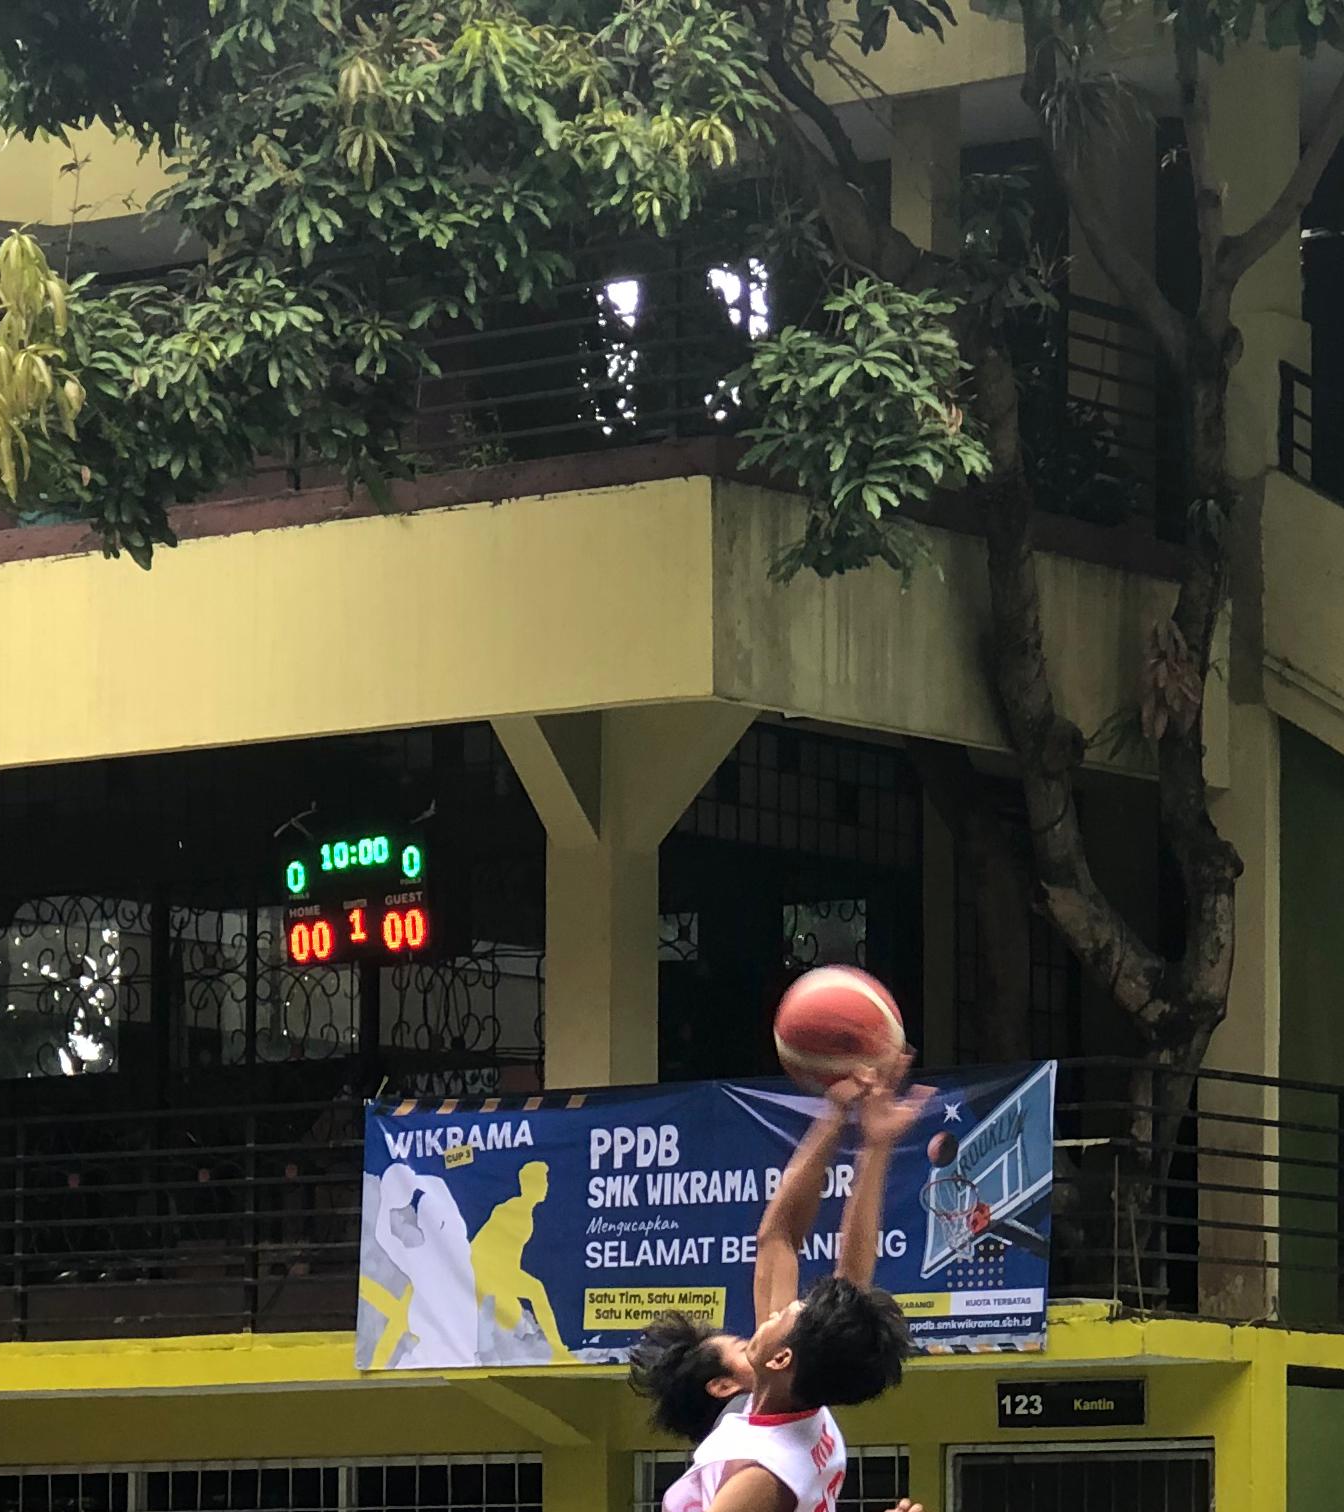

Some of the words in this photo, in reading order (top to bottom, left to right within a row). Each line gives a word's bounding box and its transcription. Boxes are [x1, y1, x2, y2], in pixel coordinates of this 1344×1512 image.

[320, 836, 389, 871] 10:00
[402, 845, 421, 878] 0
[286, 861, 305, 893] 0
[289, 905, 321, 918] HOME
[385, 891, 423, 905] GUEST
[290, 920, 332, 962] 00
[349, 908, 368, 942] 1
[382, 908, 427, 950] 00
[384, 1119, 534, 1160] WIKRAMA
[589, 1124, 680, 1170] PPDB
[446, 1152, 464, 1163] CUP
[587, 1174, 638, 1208] SMK
[646, 1168, 759, 1206] WIKRAMA
[765, 1164, 855, 1201] BOR
[586, 1214, 680, 1236] Mengucapkan
[585, 1236, 715, 1269] SELAMAT
[588, 1292, 616, 1304] Satu
[619, 1291, 645, 1305] Tim,
[647, 1292, 675, 1304] Satu
[678, 1290, 720, 1306] Mimpi,
[595, 1308, 622, 1320] Satu
[965, 1299, 991, 1307] KUOTA
[993, 1297, 1031, 1306] TERBATAS
[909, 1316, 1032, 1332] ppdb.smkwikrama.sch.id
[1000, 1395, 1043, 1415] 123
[1073, 1399, 1114, 1411] Kantin
